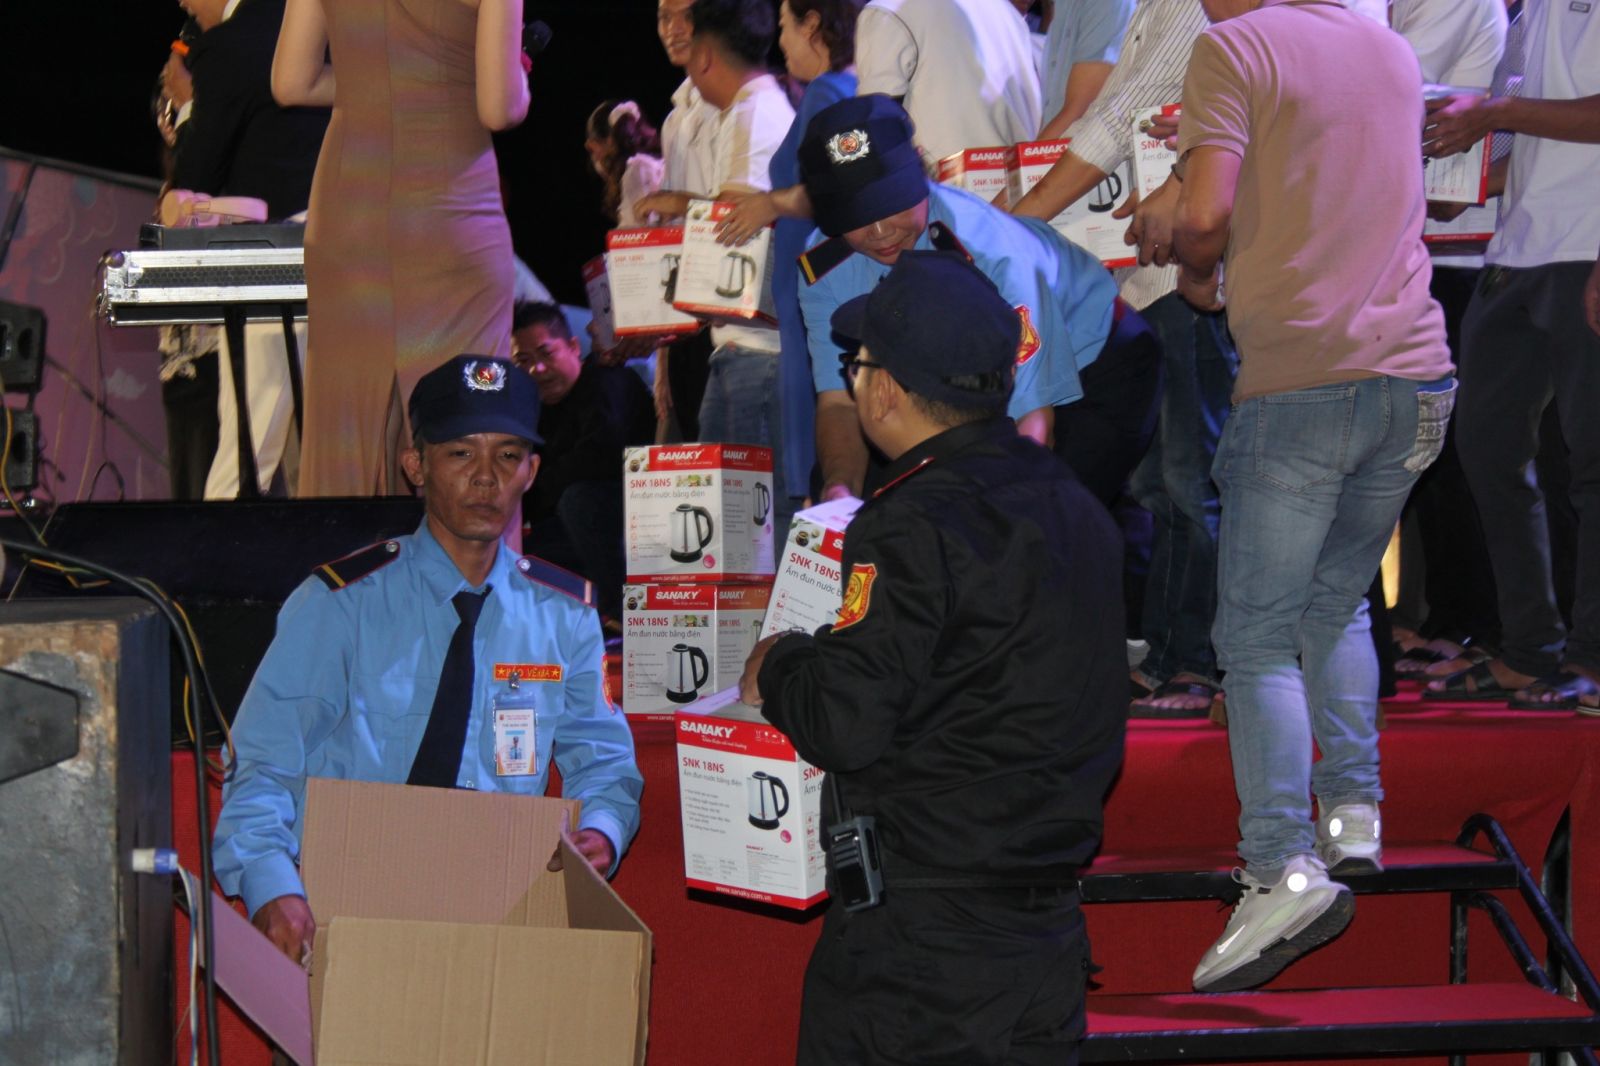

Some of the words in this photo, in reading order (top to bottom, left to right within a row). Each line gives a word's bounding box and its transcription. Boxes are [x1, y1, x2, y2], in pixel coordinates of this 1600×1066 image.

[970, 152, 1004, 161] SANAK
[657, 450, 702, 461] SANAKY
[723, 450, 748, 460] SANAKY
[630, 480, 647, 488] SNK
[650, 478, 672, 488] 18NS
[790, 552, 812, 569] SNK
[814, 563, 840, 582] 18NS
[656, 591, 699, 600] SANAKY
[719, 592, 744, 600] SANAKY
[628, 617, 644, 626] SNK
[648, 617, 668, 626] 18NS
[680, 720, 734, 738] SANAKY
[682, 757, 700, 768] SNK
[702, 761, 724, 773] 18NS
[716, 886, 772, 902] www.sanaky.com.vn
